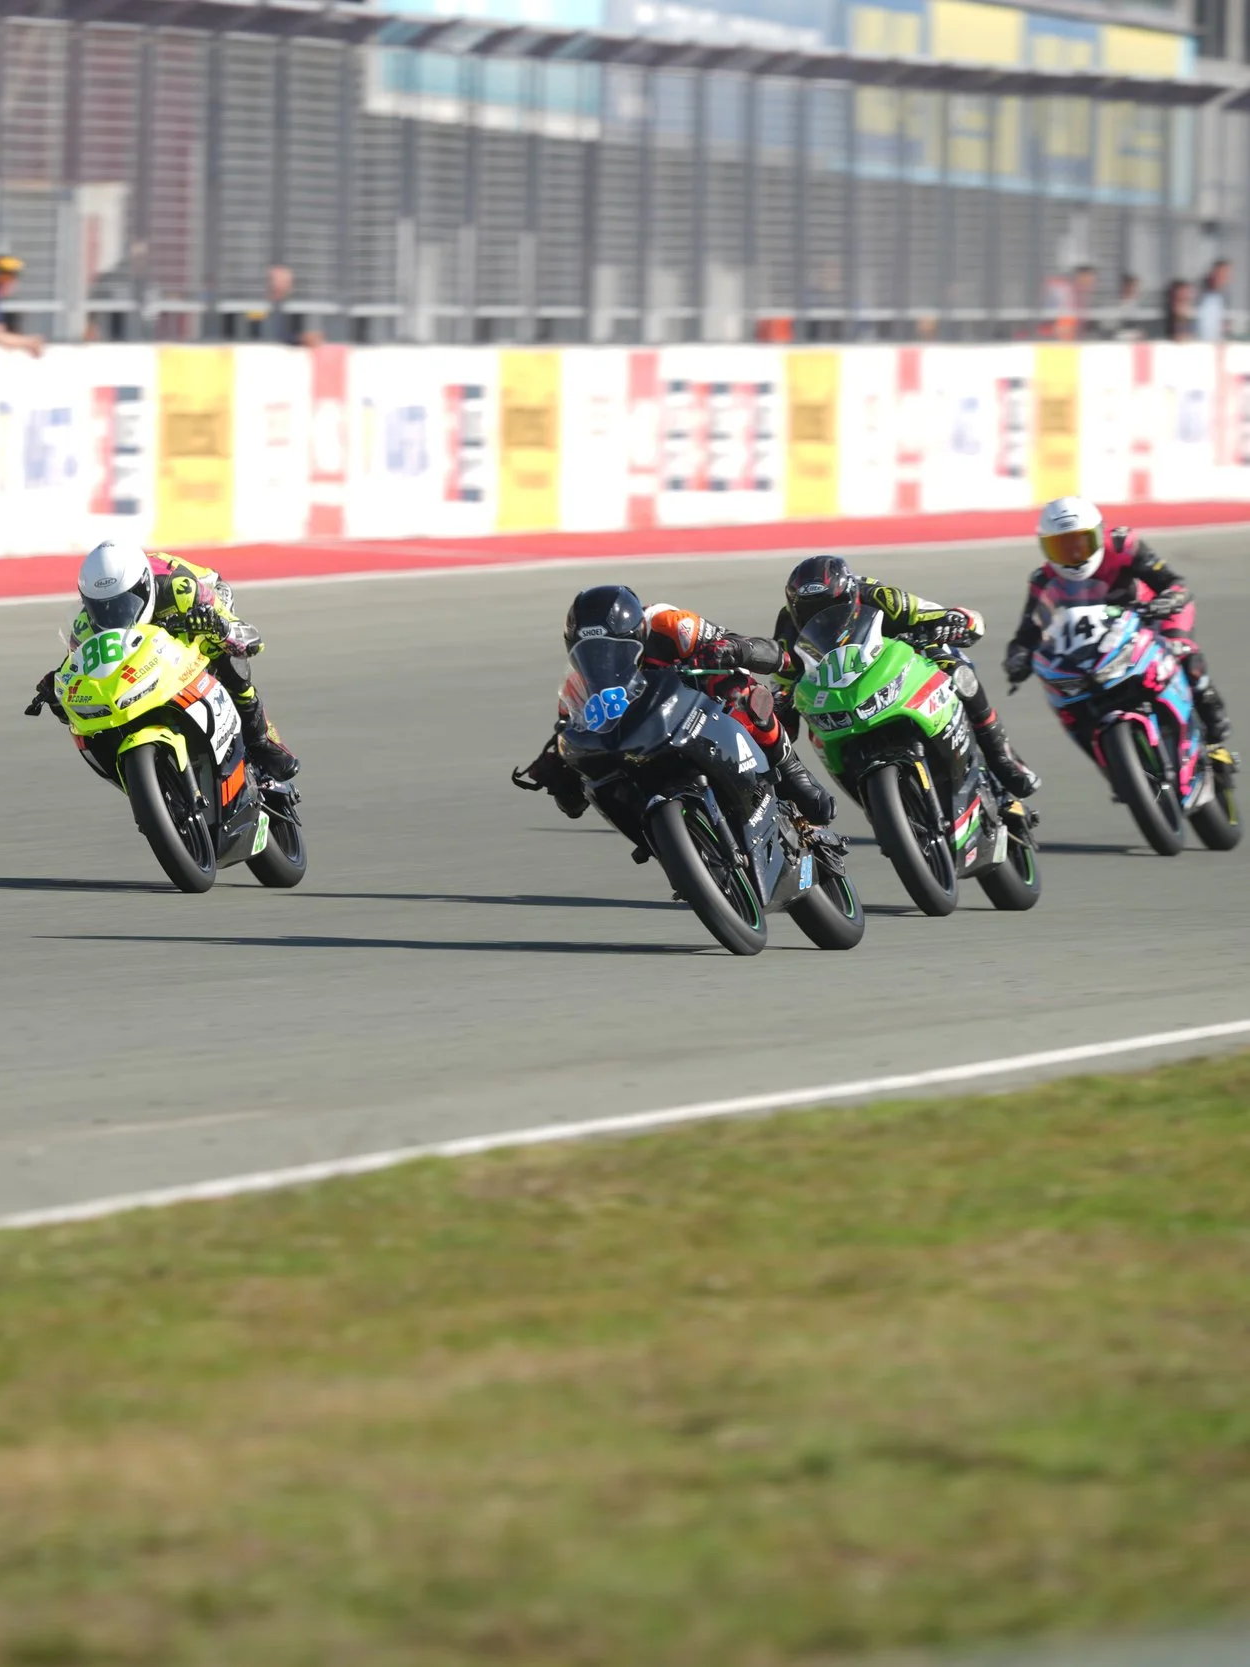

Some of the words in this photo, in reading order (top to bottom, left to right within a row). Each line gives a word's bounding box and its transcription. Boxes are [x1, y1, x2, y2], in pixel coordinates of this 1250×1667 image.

[582, 628, 603, 637] SHOEI
[1062, 616, 1095, 648] 14
[82, 631, 123, 675] 86
[817, 646, 867, 687] 114
[583, 686, 629, 731] 98
